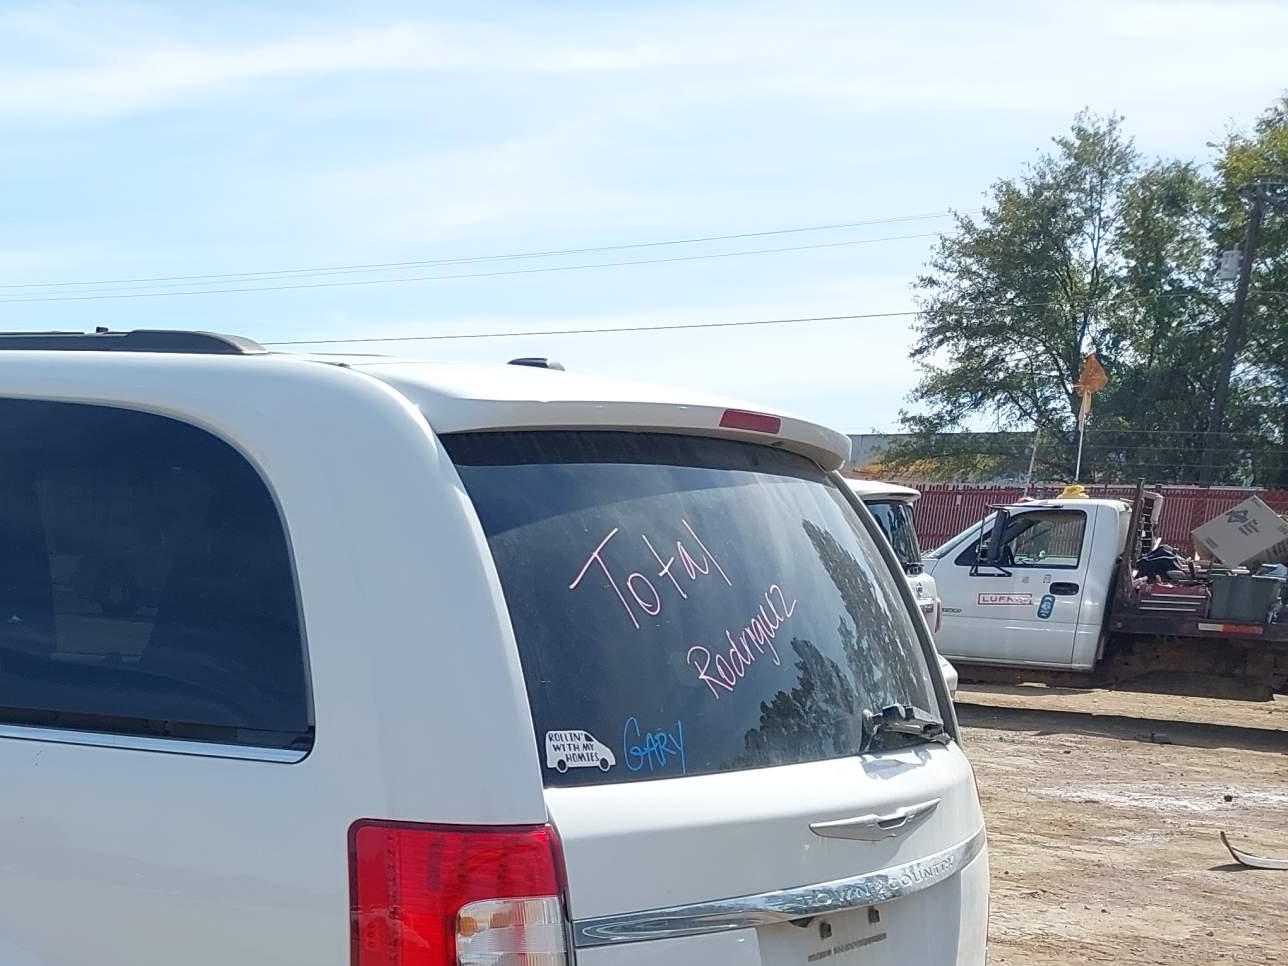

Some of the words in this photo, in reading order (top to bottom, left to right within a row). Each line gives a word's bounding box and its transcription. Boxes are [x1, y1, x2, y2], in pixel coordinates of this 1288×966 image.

[568, 518, 732, 630] Total
[548, 731, 584, 743] ROLLIN'
[552, 743, 580, 753] WITH
[582, 742, 594, 751] MY
[565, 751, 600, 763] HOMIES
